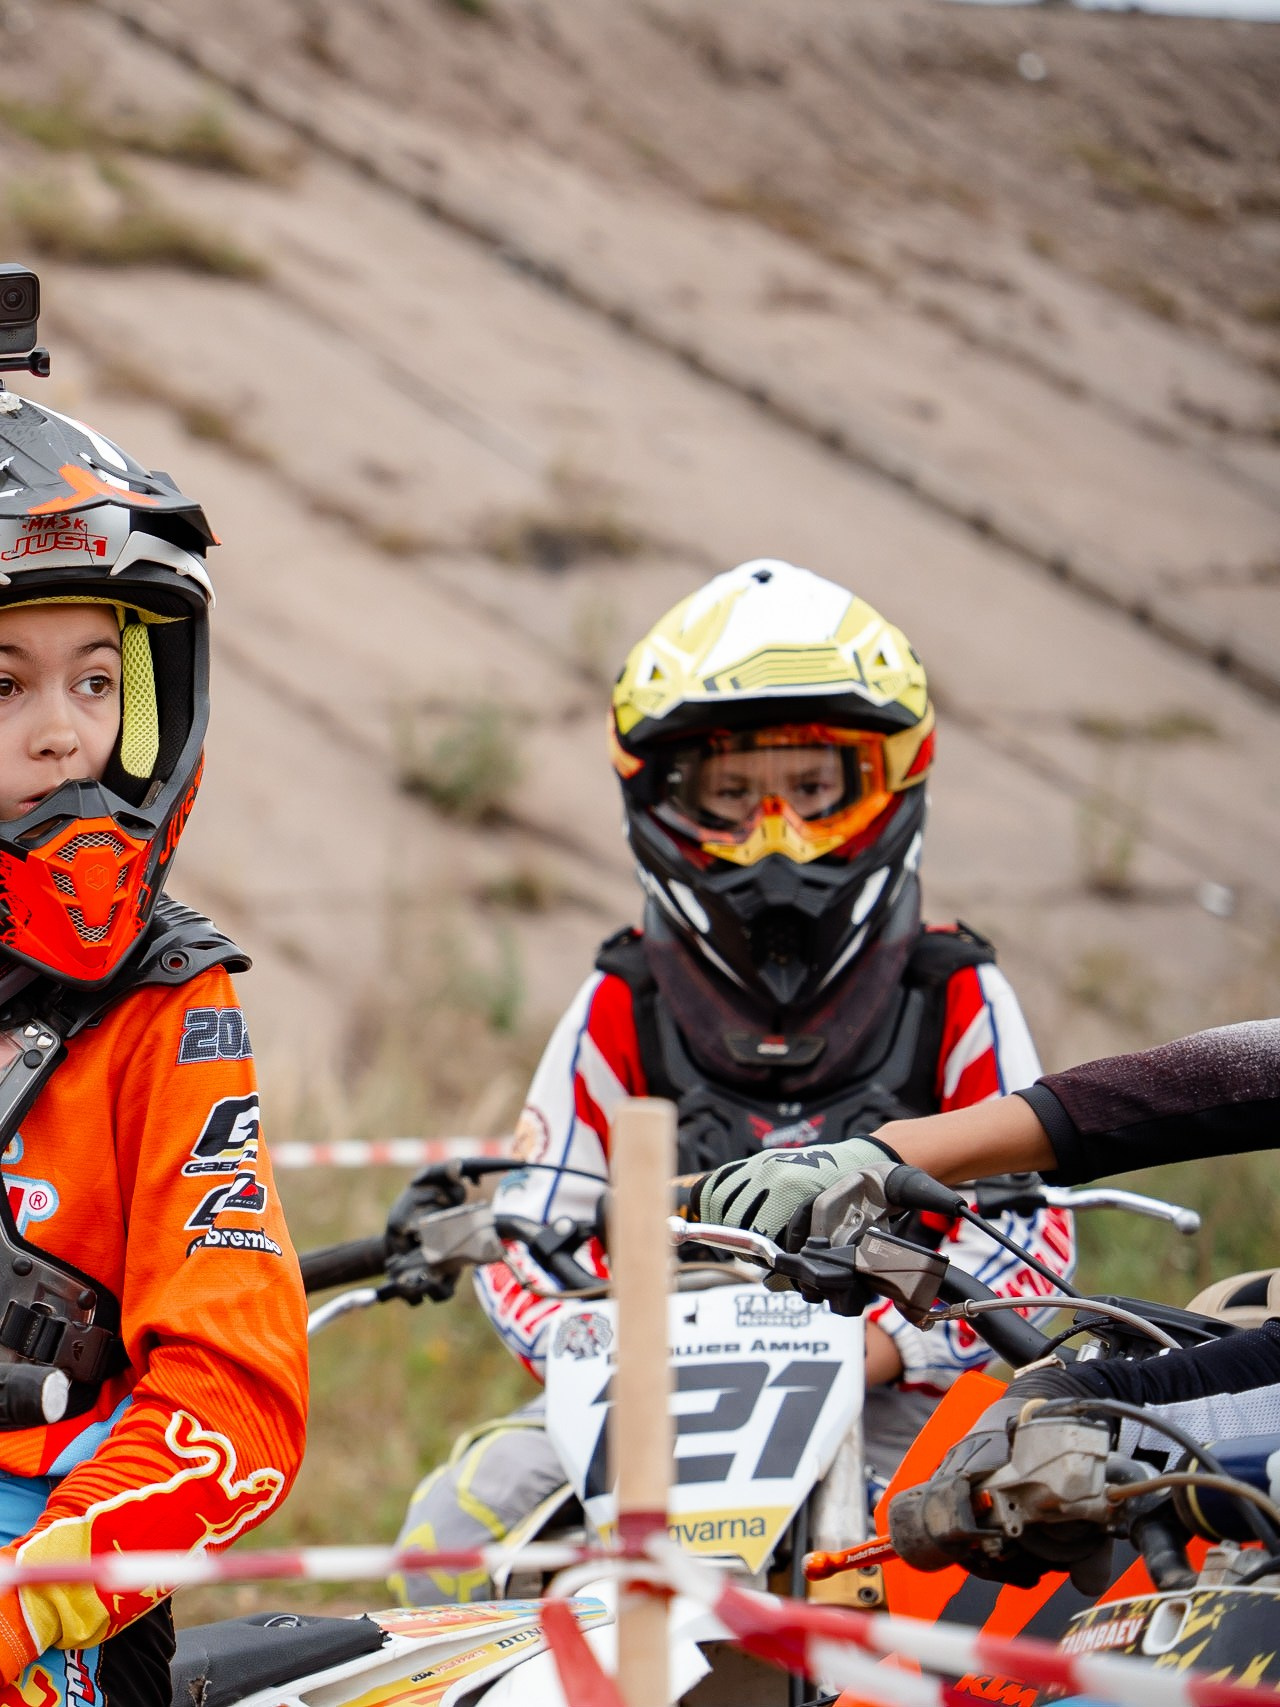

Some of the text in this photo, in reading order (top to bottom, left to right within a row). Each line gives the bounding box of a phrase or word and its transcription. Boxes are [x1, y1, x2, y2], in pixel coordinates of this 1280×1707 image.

[1, 532, 108, 560] JUST1
[749, 1339, 830, 1355] Амир
[868, 1543, 892, 1556] Racin
[497, 1626, 545, 1649] DUN
